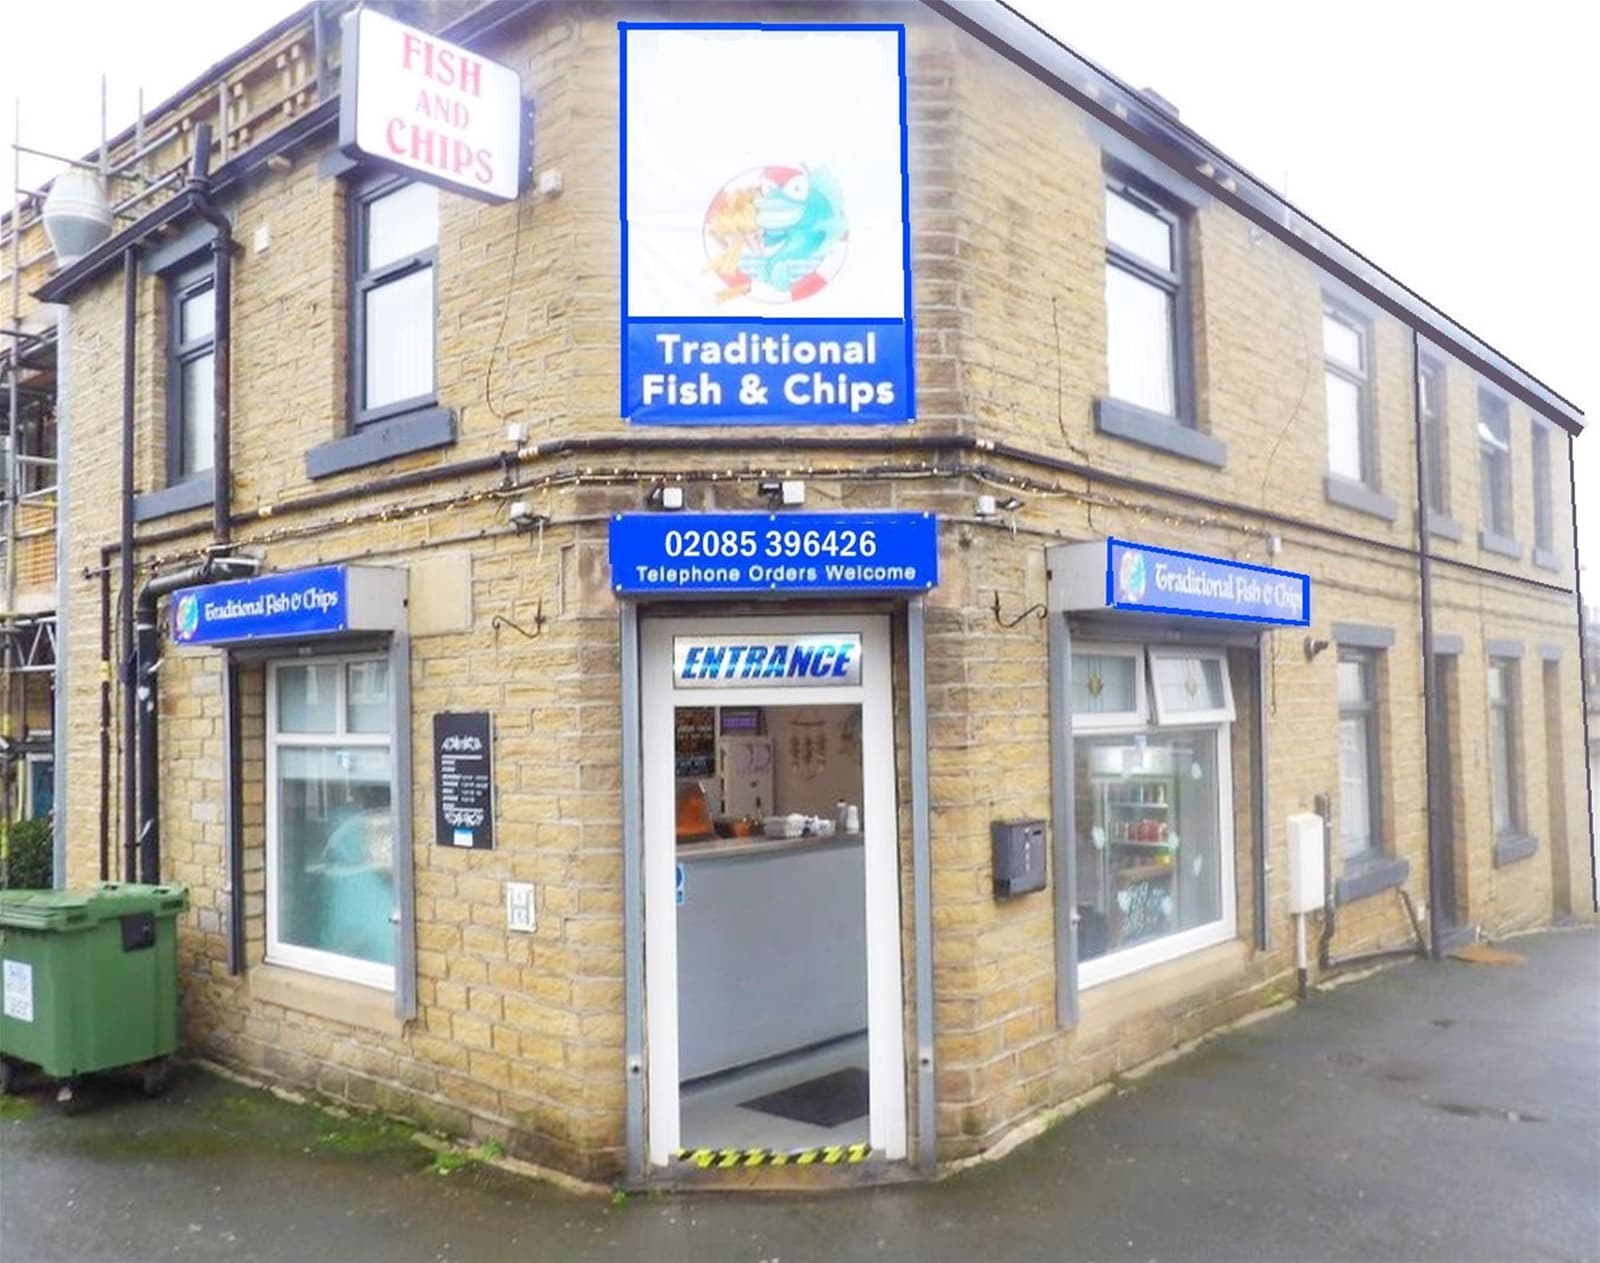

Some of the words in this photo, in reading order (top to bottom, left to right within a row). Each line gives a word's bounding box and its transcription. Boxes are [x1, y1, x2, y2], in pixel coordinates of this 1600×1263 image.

[402, 31, 482, 97] FISH
[416, 88, 470, 129] AND
[386, 117, 493, 184] CHIPS
[656, 332, 876, 365] Traditional
[642, 373, 722, 405] Fish
[738, 373, 769, 405] &
[784, 373, 895, 413] Chips
[665, 530, 756, 557] 02085
[765, 530, 877, 557] 396426
[636, 565, 740, 584] Telephone
[748, 565, 817, 582] Orders
[825, 564, 916, 580] Welcome
[1155, 563, 1234, 600] Traditional
[204, 595, 264, 622] Traditional
[265, 592, 290, 616] Fish
[303, 587, 338, 613] Chips
[681, 645, 854, 679] ENTRANCE
